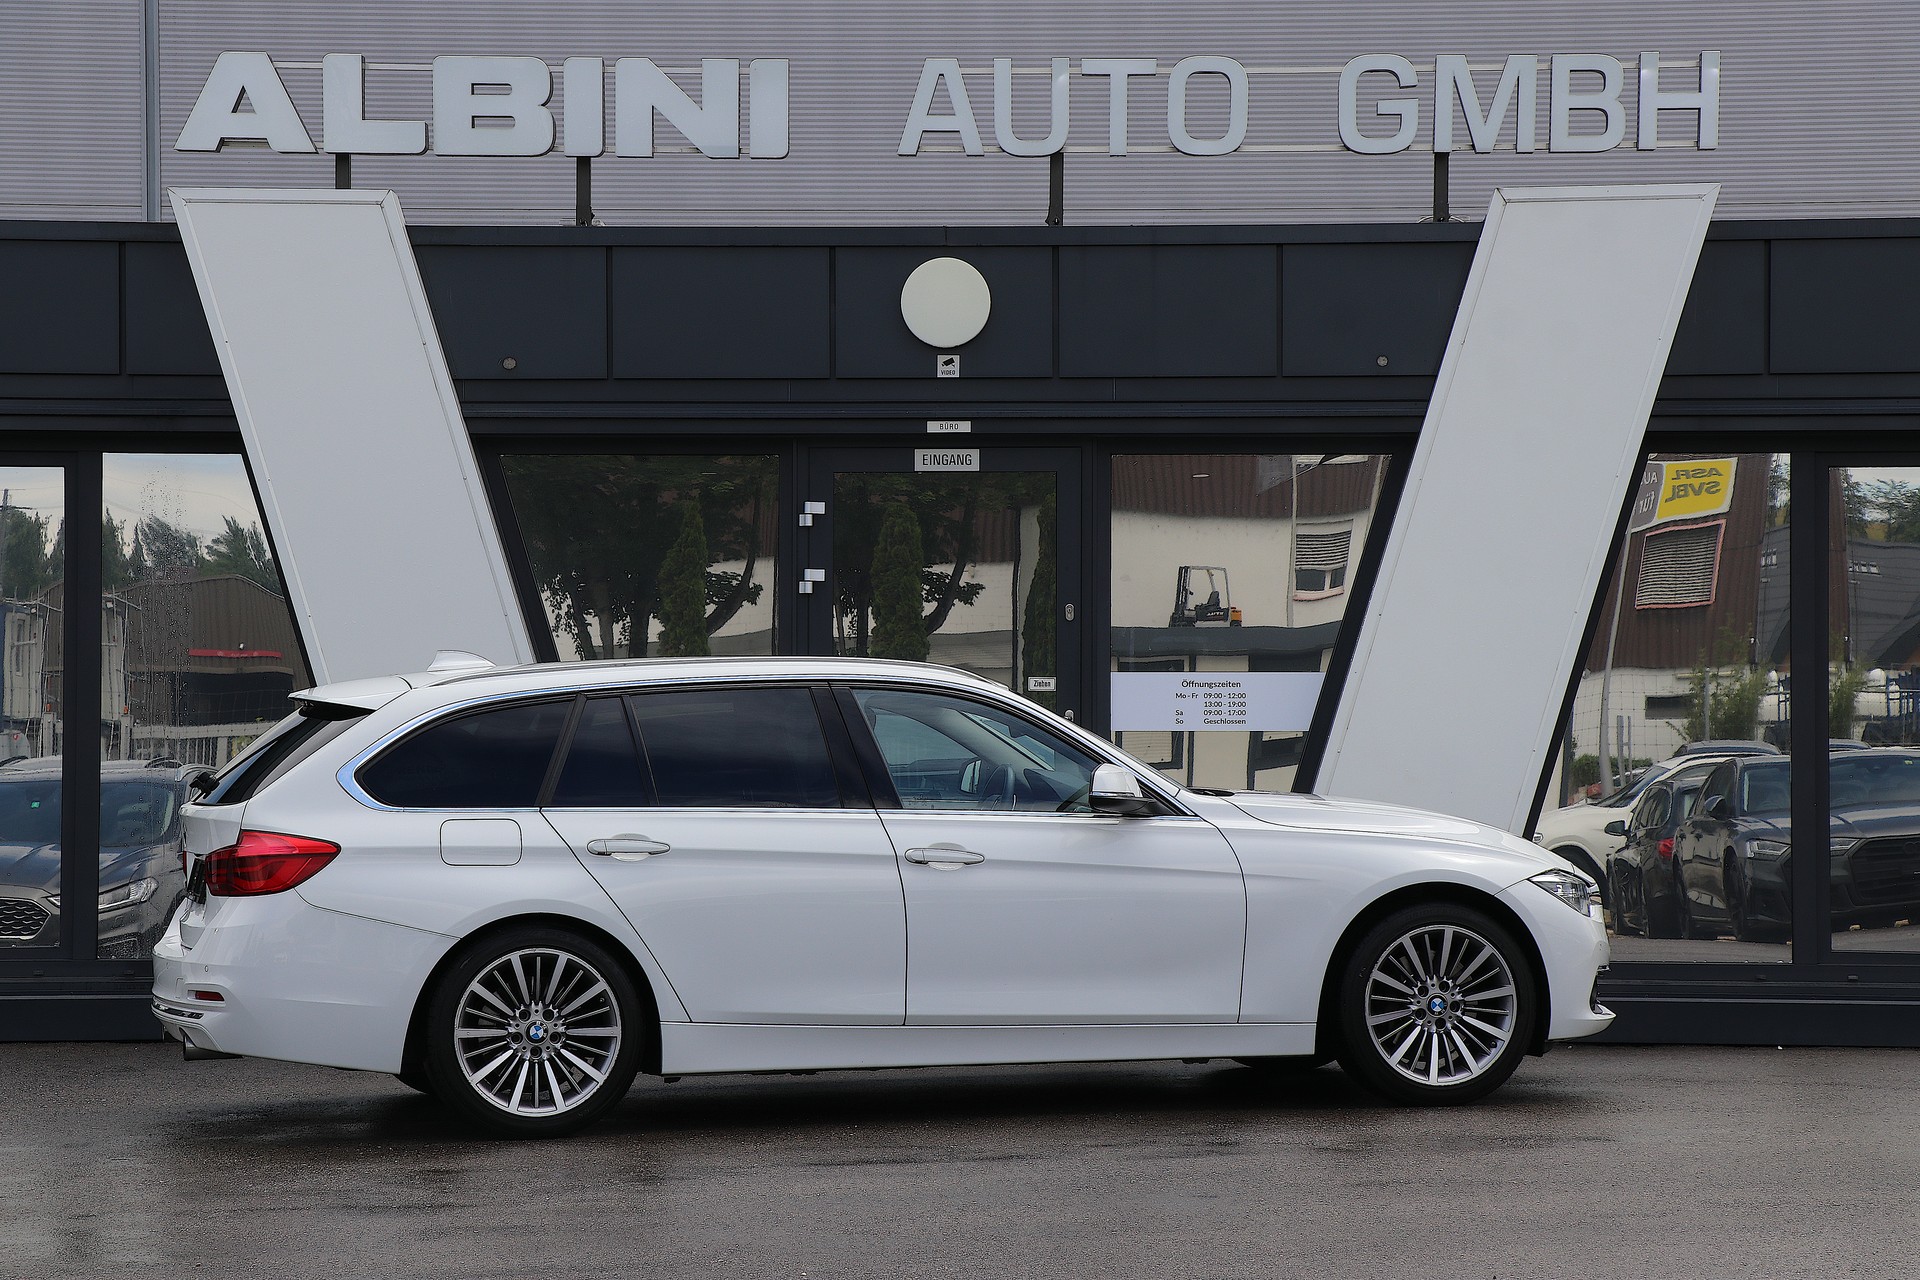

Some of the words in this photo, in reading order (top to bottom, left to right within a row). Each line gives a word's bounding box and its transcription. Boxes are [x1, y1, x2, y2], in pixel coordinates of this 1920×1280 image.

[174, 50, 790, 159] ALBINI
[897, 55, 1249, 157] AUTO
[1338, 50, 1721, 154] GMBH
[940, 422, 958, 430] BÜRO
[922, 454, 972, 466] EINGANG
[1181, 679, 1241, 689] Öffnungszeiten
